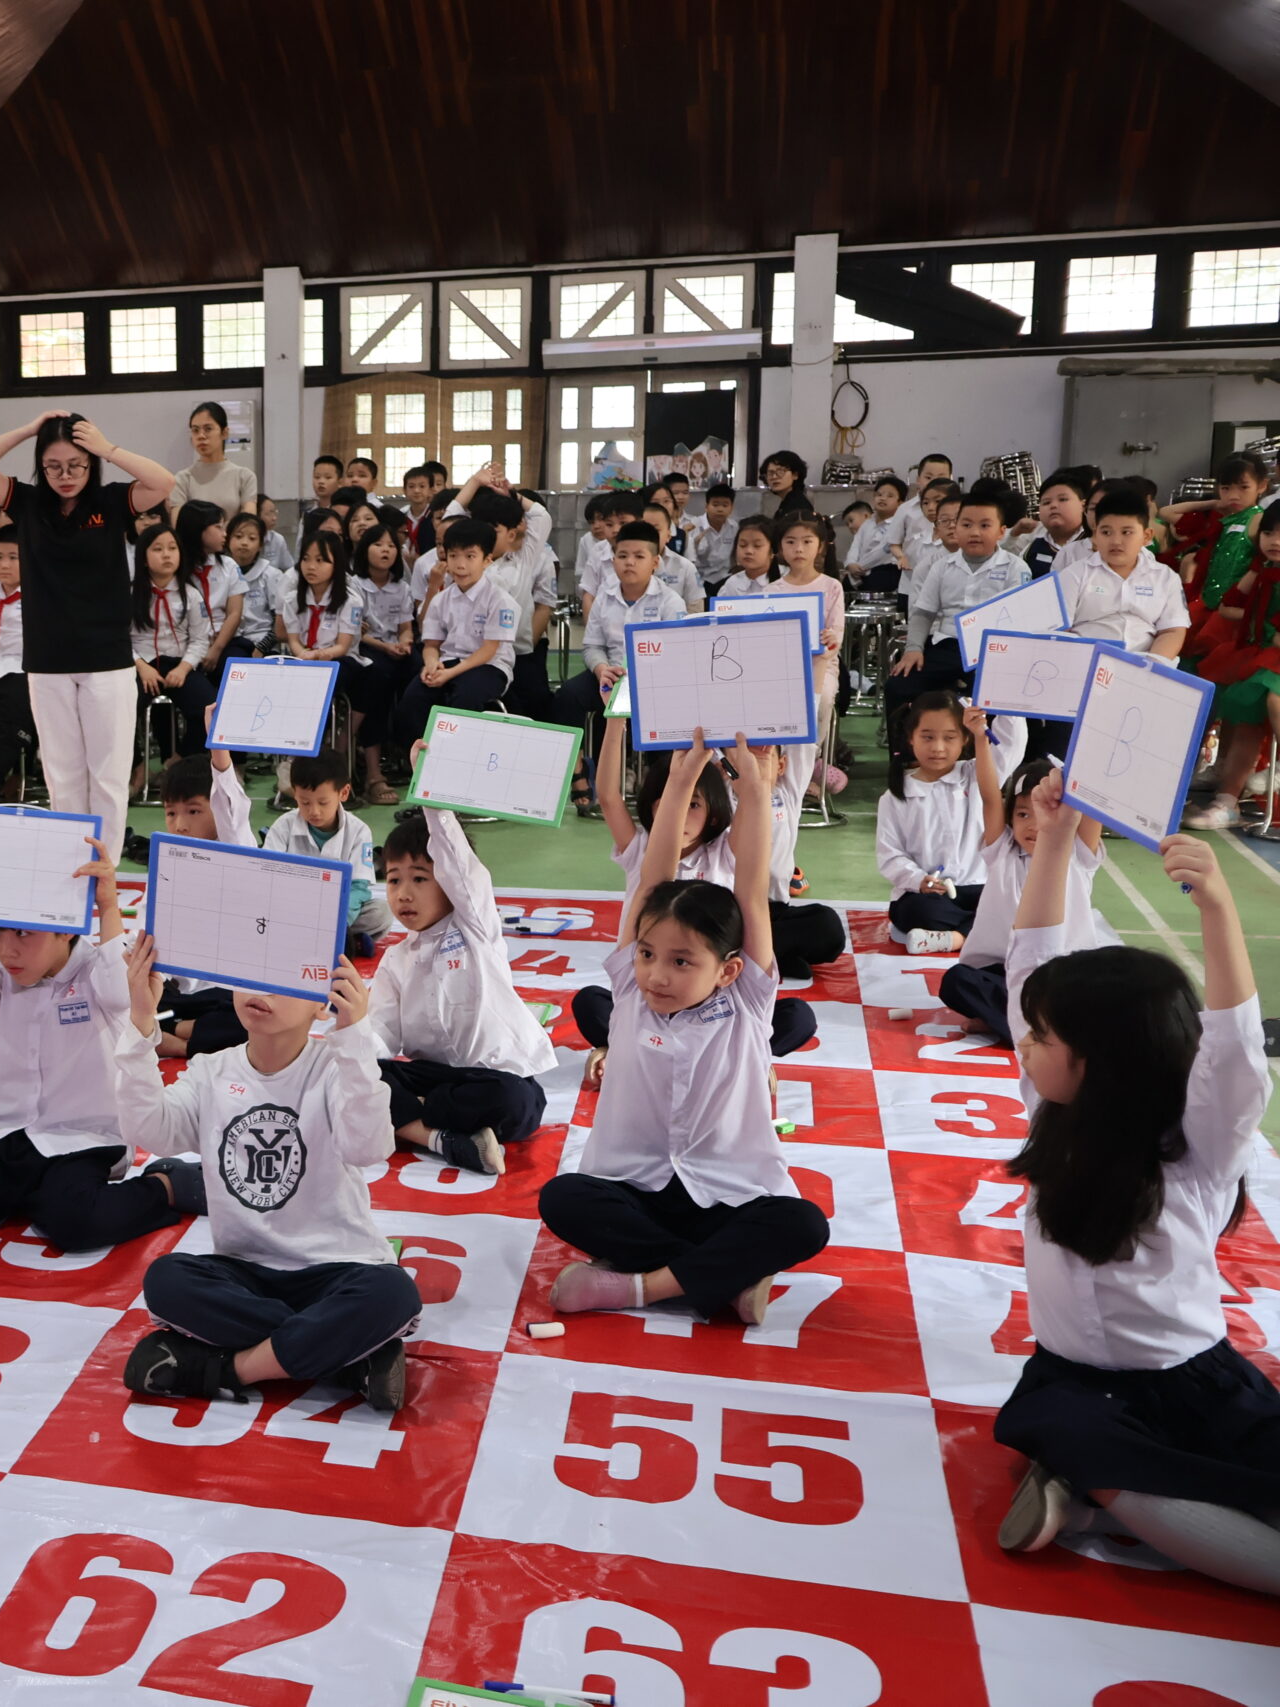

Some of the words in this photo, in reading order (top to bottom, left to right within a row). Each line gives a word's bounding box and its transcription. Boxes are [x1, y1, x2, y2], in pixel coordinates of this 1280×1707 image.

[710, 636, 743, 682] B
[1022, 660, 1060, 698] B
[250, 696, 273, 733] B
[1104, 706, 1144, 778] B
[486, 752, 499, 772] B
[228, 1083, 246, 1096] 54
[227, 1110, 277, 1148] AMERICAN
[227, 1167, 248, 1194] NEW
[278, 1169, 300, 1198] CITY
[553, 1390, 865, 1526] 55
[512, 1596, 883, 1707] 63
